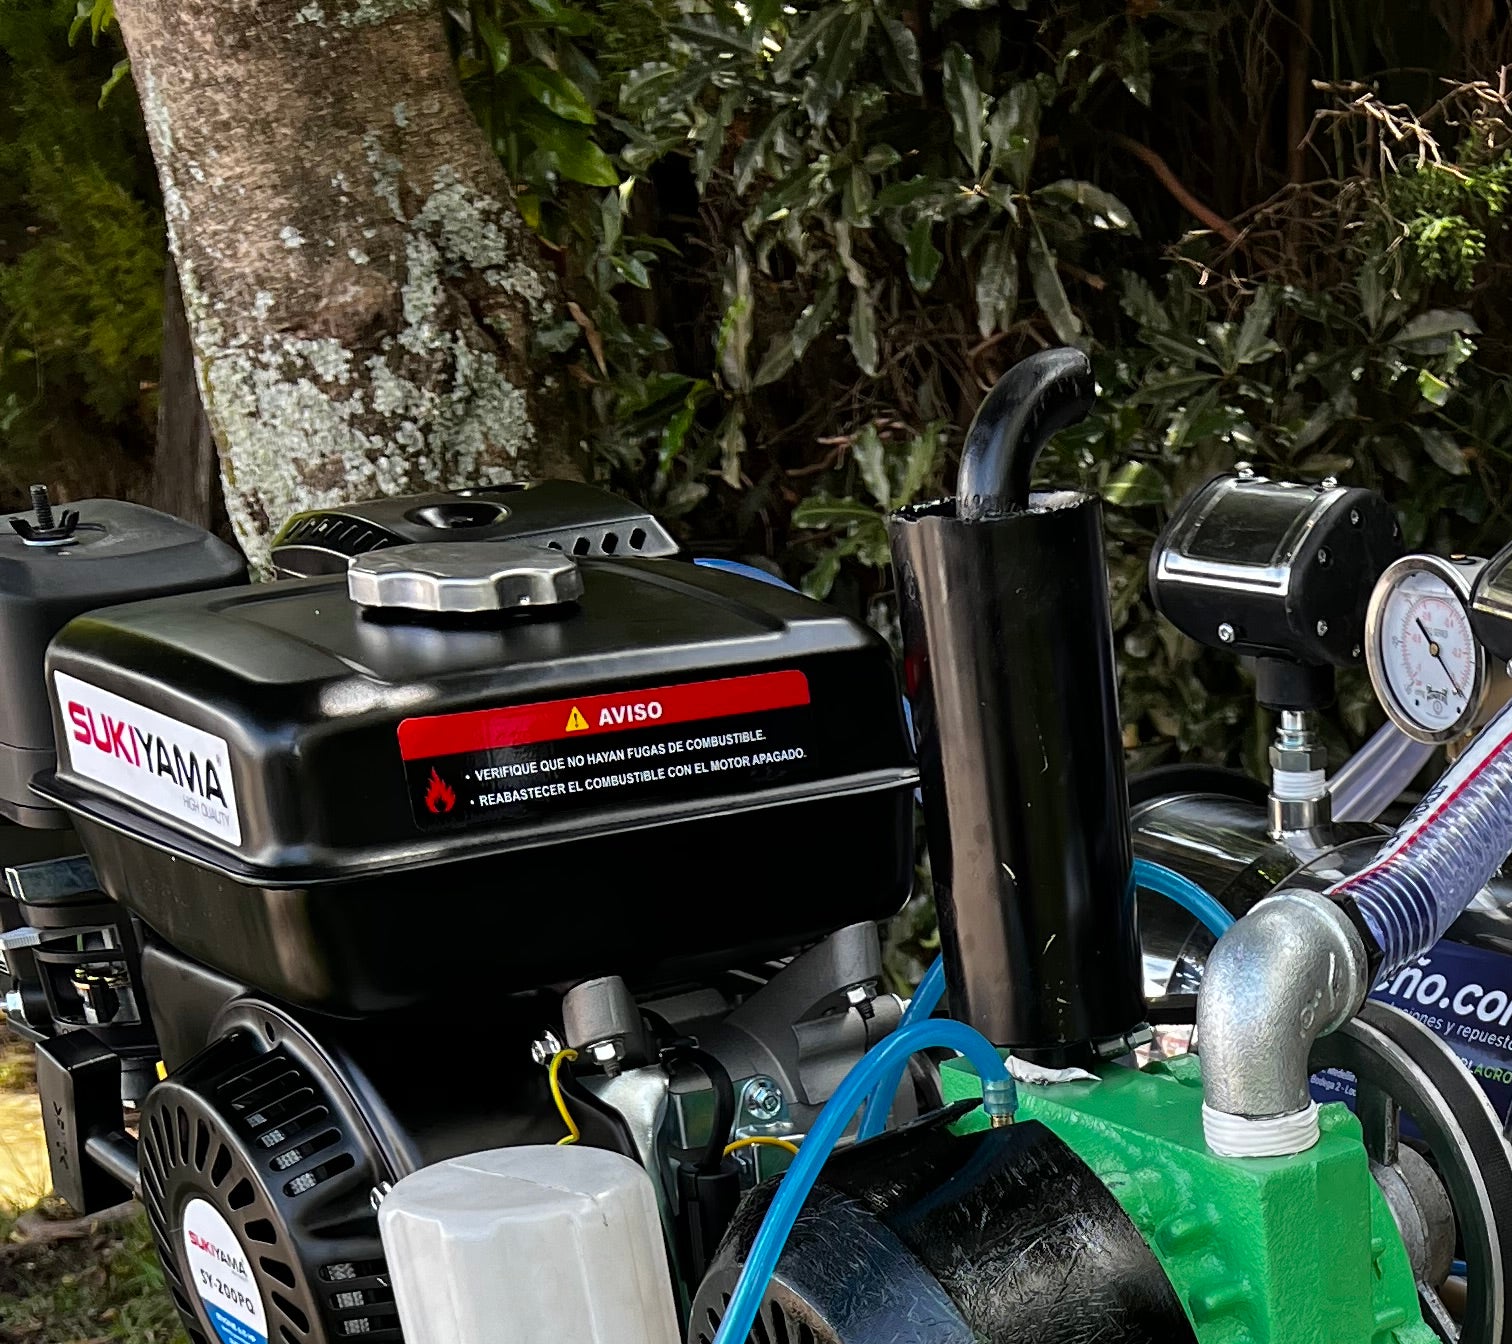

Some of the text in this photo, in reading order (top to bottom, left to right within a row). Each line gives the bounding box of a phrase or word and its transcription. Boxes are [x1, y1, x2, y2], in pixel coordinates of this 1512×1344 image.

[599, 701, 663, 726] AVISO
[68, 701, 228, 808] SUKIYAMA
[475, 729, 767, 782] VERIFIQUE QUE NO HAYAN FUGAS DE COMBUSTIBLE.
[479, 747, 807, 807] REABASTECER EL COMBUSTIBLE CON EL MOTOR APAGADO.
[1443, 1021, 1455, 1036] y
[188, 1230, 247, 1275] SUKIYAMA
